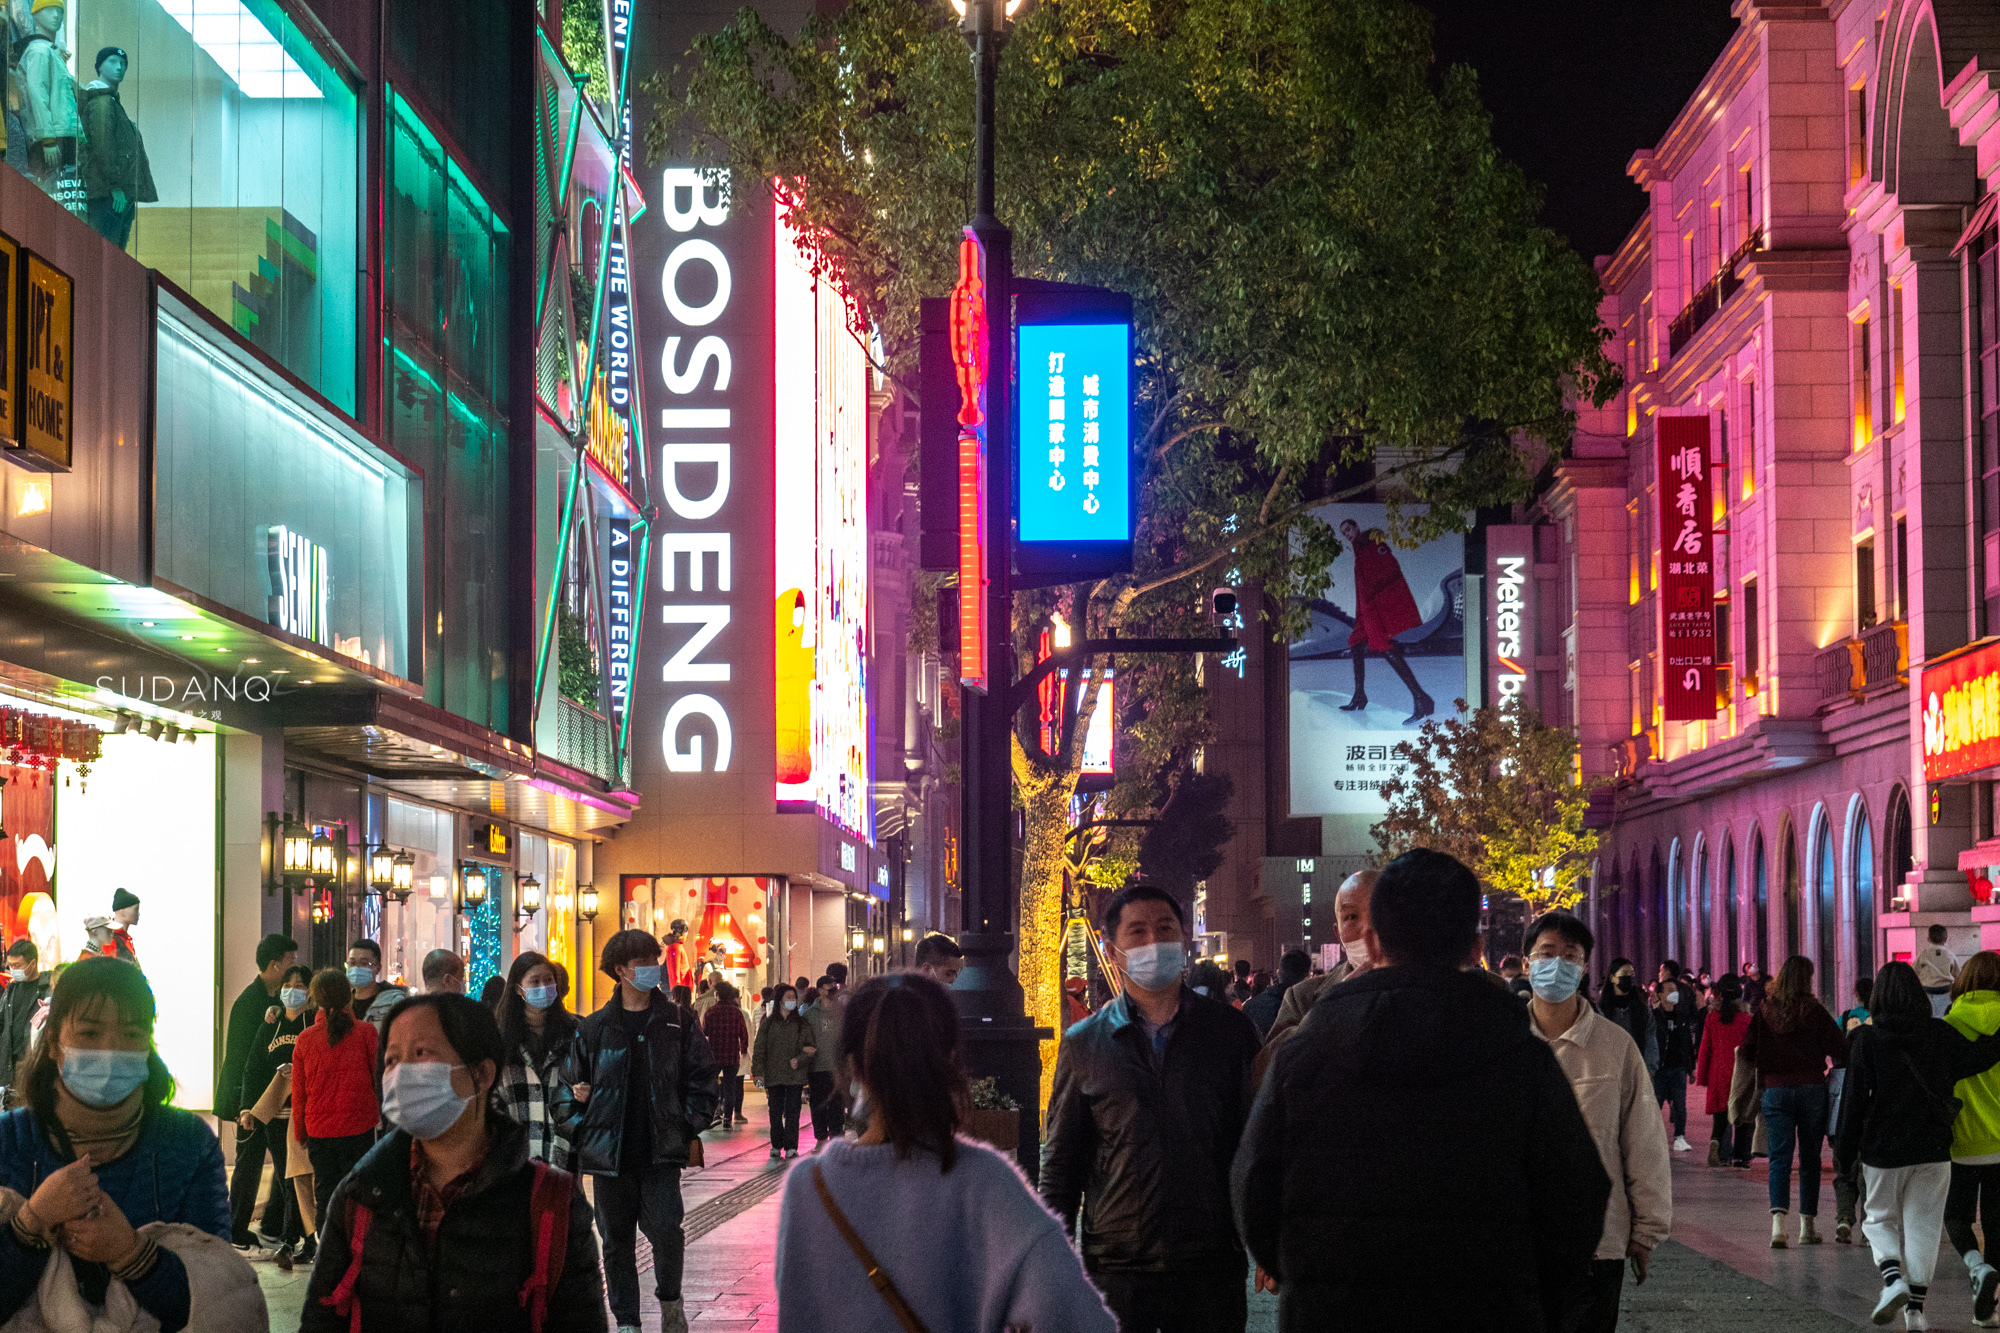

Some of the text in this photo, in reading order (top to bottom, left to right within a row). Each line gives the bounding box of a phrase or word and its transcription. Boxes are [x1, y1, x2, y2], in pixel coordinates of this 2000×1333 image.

[611, 305, 629, 405] WORLD
[29, 384, 63, 441] HOME
[662, 168, 731, 772] BOSIDENG
[612, 528, 628, 546] A
[278, 524, 328, 647] SEMIR
[1669, 562, 1708, 575] 湖北菜
[96, 675, 270, 702] SUDANQ
